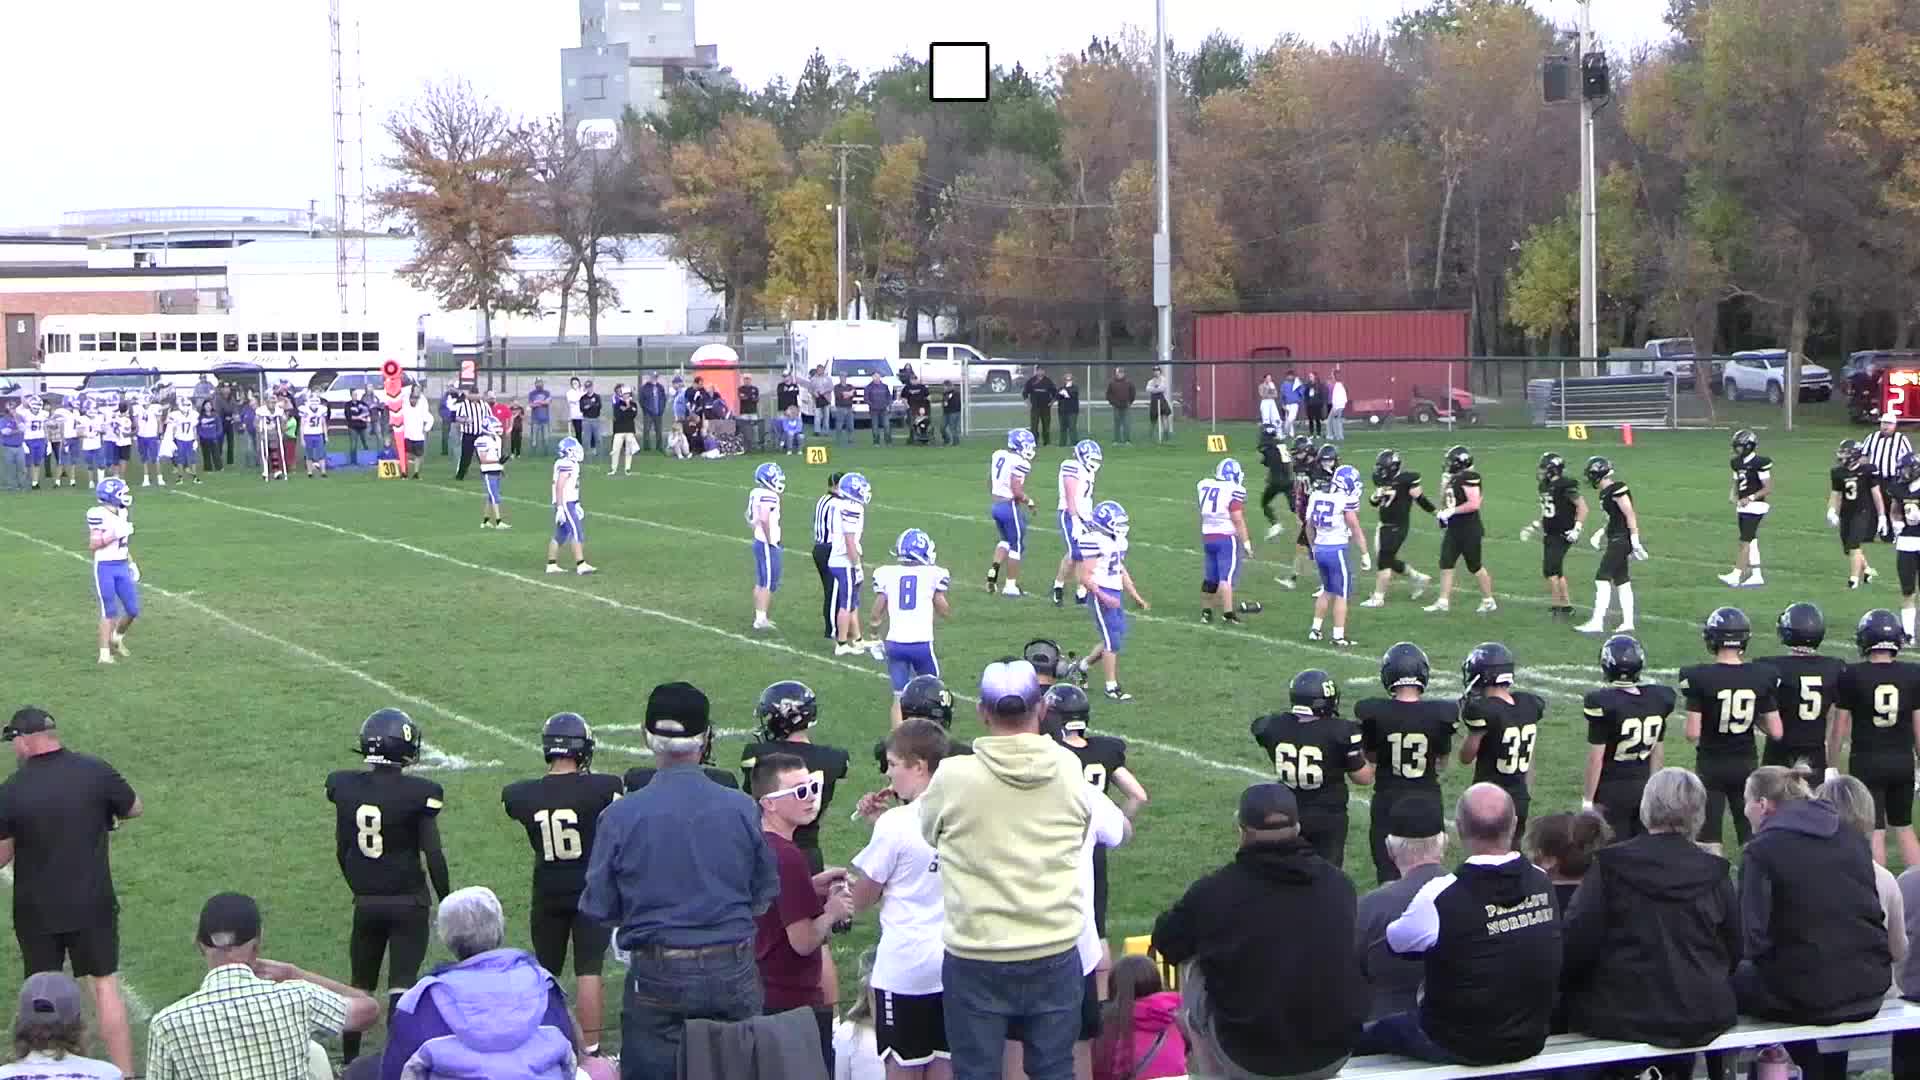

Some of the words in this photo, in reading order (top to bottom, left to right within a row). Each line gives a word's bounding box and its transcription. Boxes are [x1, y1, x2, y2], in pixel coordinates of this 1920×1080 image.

[1212, 437, 1223, 450] 10
[1575, 426, 1583, 439] G
[383, 462, 396, 476] 30
[811, 449, 824, 463] 20
[995, 457, 1006, 480] 9
[1738, 473, 1748, 491] 2
[1844, 481, 1858, 501] 3
[1201, 486, 1220, 513] 79
[1311, 500, 1335, 527] 62
[899, 575, 918, 611] 8
[1717, 689, 1757, 734] 19
[1798, 675, 1824, 721] 5
[1873, 684, 1899, 728] 9
[402, 724, 412, 742] 8
[1613, 715, 1664, 762] 29
[1387, 733, 1429, 779] 13
[1497, 723, 1537, 775] 33
[1275, 742, 1323, 790] 66
[356, 804, 383, 859] 8
[533, 808, 583, 862] 16
